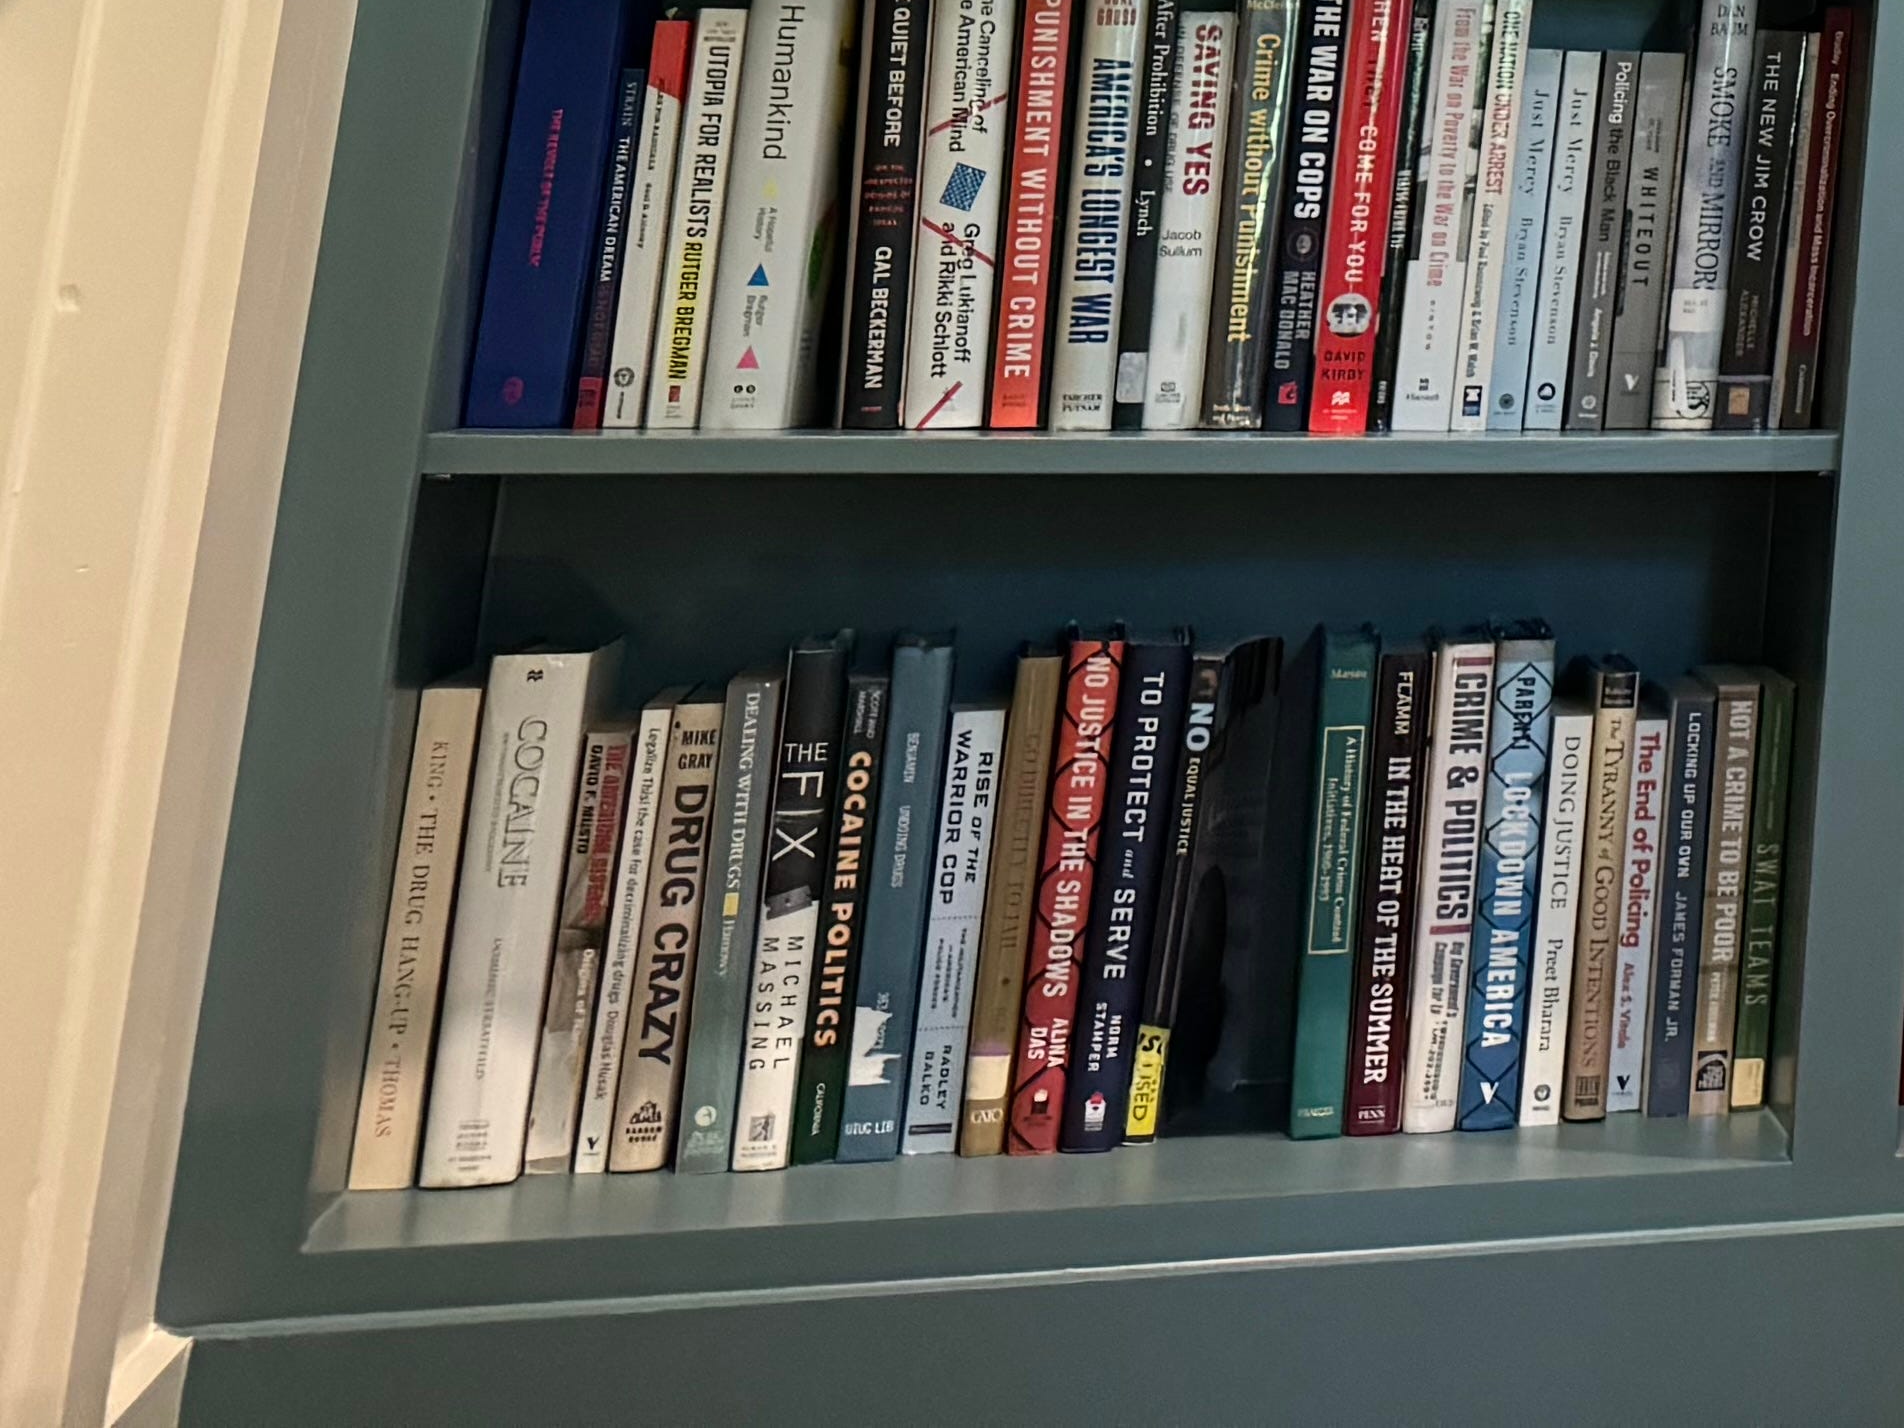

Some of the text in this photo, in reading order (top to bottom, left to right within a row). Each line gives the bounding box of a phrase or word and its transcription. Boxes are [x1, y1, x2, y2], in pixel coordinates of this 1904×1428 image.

[889, 7, 910, 68] QUIET
[951, 14, 973, 104] American
[975, 18, 995, 118] Canceling
[1308, 47, 1337, 102] WAR
[761, 5, 805, 160] Humankind
[883, 72, 907, 147] BEFORE
[1182, 24, 1223, 196] SAVING YES
[1308, 106, 1329, 142] ON
[947, 107, 968, 153] Mind
[970, 120, 987, 134] of
[1293, 148, 1327, 220] COPS
[1010, 169, 1049, 286] WITHOUT
[1159, 244, 1201, 257] Sullum
[1162, 229, 1200, 242] Jacob
[864, 245, 893, 389] GAL BECKERMAN
[1003, 295, 1036, 379] CRIME
[679, 753, 713, 769] GRAY
[681, 729, 716, 745] MIKE
[784, 742, 828, 762] THE
[500, 715, 548, 889] COCAINE
[772, 771, 824, 859] FIX
[1435, 672, 1488, 922] CRIME & POLITICS
[638, 784, 708, 1066] DRUG CRAZY
[812, 751, 871, 1047] COCAINE POLITICS
[1481, 770, 1534, 1049] LOCKDOWN AMERICA
